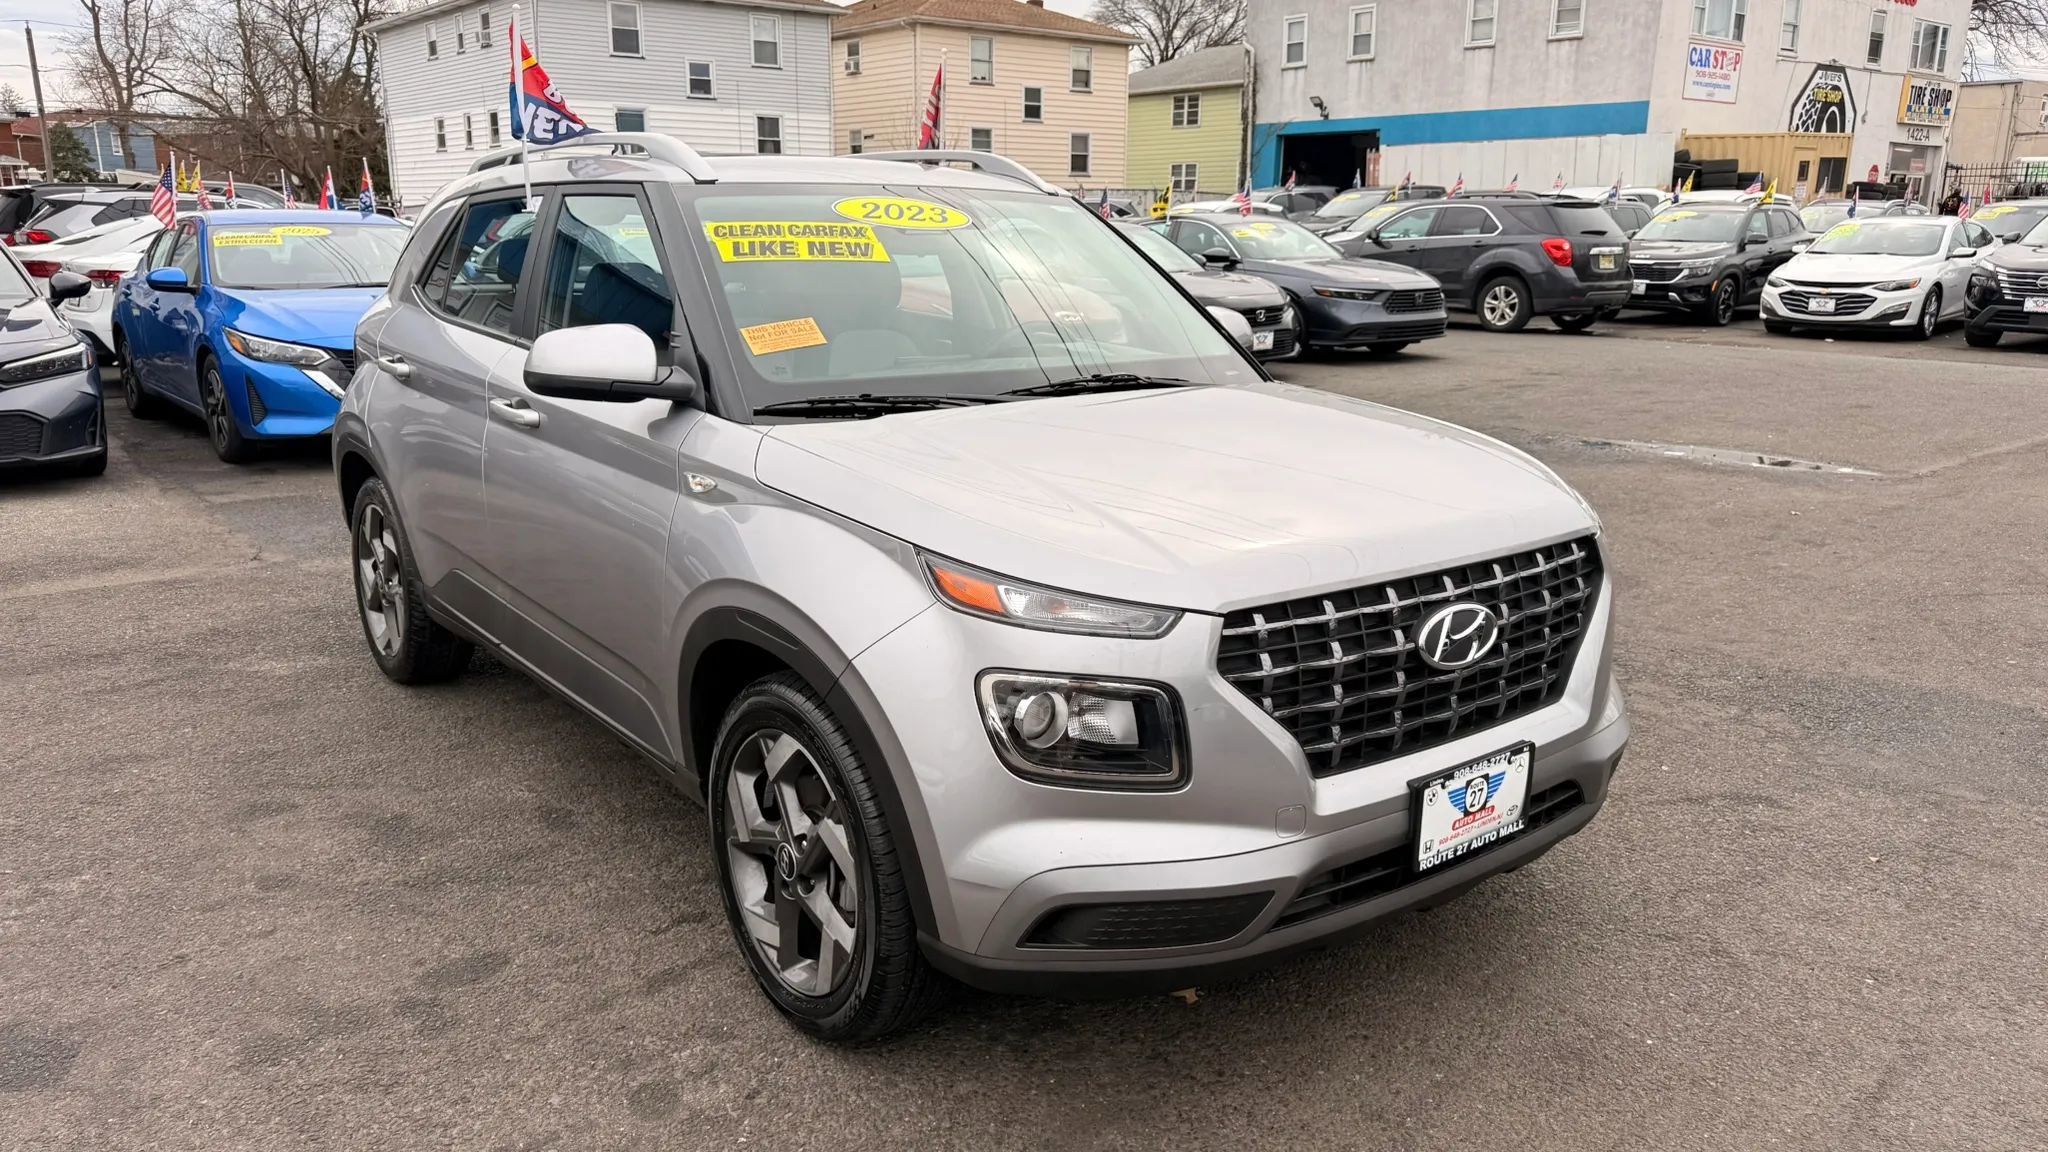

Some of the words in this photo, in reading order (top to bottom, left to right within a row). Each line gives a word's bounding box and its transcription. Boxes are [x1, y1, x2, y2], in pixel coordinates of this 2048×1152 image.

[1689, 47, 1711, 68] CAR
[1712, 50, 1741, 72] STOP
[1814, 88, 1827, 102] TIRE
[1827, 90, 1842, 104] SHOP
[1909, 85, 1927, 105] TIRE
[1928, 87, 1952, 108] SHOP
[1907, 127, 1930, 142] 1422-A
[861, 201, 948, 224] 2023
[713, 224, 783, 239] CLEAN
[788, 224, 866, 239] CARFAX
[732, 240, 798, 258] LIKE
[807, 240, 873, 259] NEW
[746, 325, 768, 335] THIS
[769, 319, 812, 331] VEHICLE
[749, 333, 767, 342] Not
[768, 330, 788, 338] FOR
[791, 324, 816, 334] SALE
[1470, 780, 1485, 790] ROUTE
[1469, 788, 1484, 809] 27
[1454, 816, 1473, 829] AUTO
[1475, 808, 1492, 821] MALL
[1419, 847, 1455, 871] ROUTE
[1455, 842, 1468, 856] 27
[1470, 831, 1497, 850] AUTO
[1499, 819, 1525, 838] MALL
